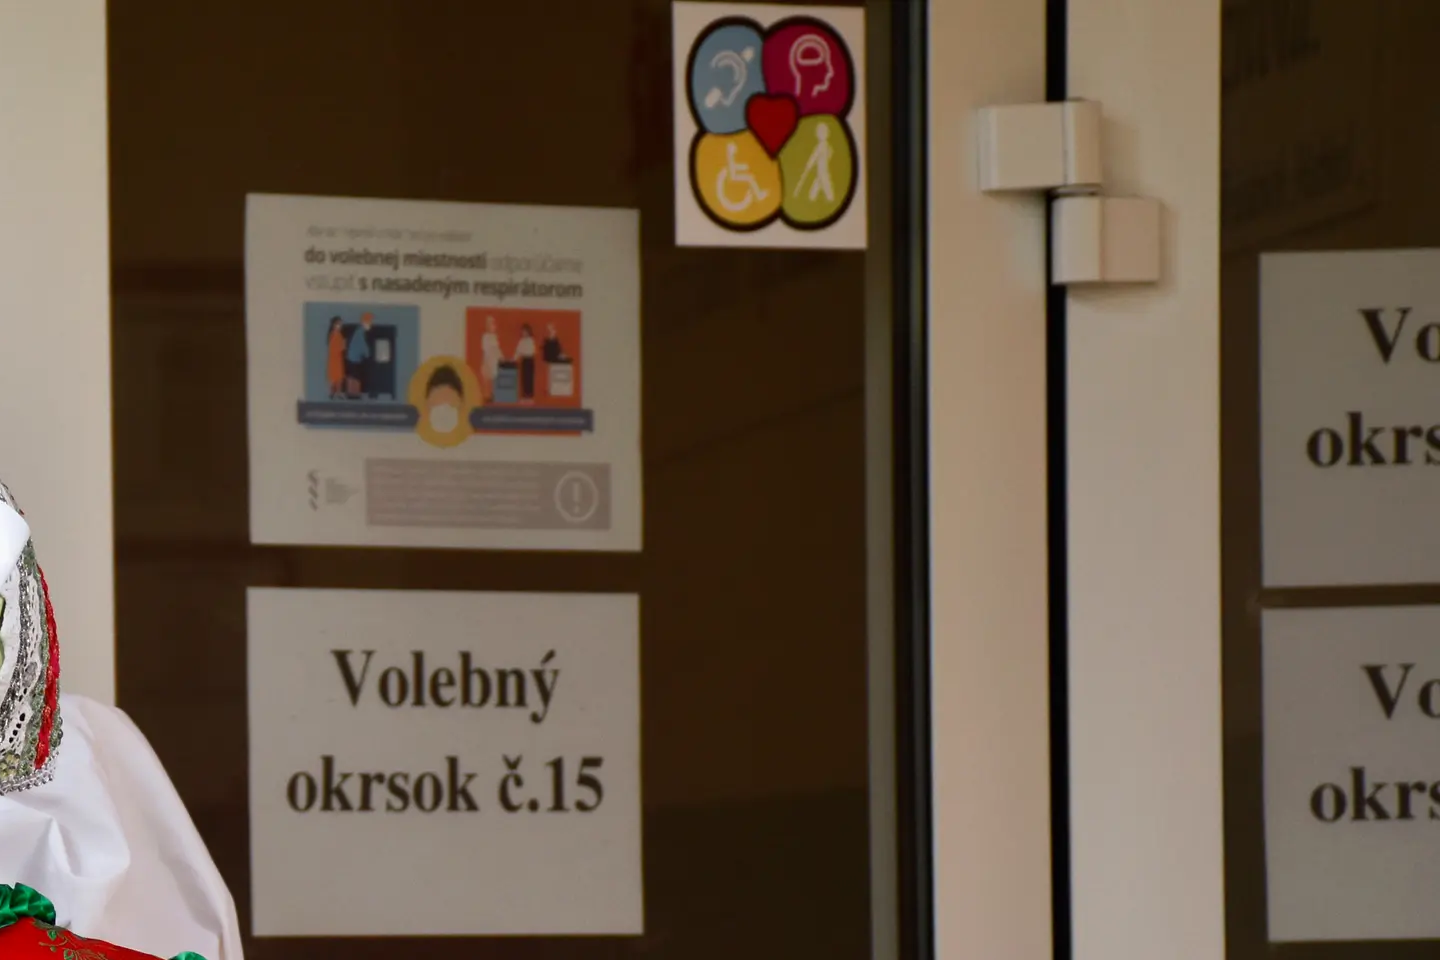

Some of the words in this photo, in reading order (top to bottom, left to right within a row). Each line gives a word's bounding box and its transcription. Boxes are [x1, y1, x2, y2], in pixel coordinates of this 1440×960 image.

[304, 246, 326, 264] do
[330, 247, 400, 271] volebnej
[403, 250, 488, 270] miestnosti
[358, 277, 369, 291] s
[371, 274, 470, 299] nasadeným
[473, 277, 584, 303] respirátorom
[331, 649, 560, 725] Volebný
[286, 755, 480, 813] okrsok
[498, 754, 604, 813] č.15
